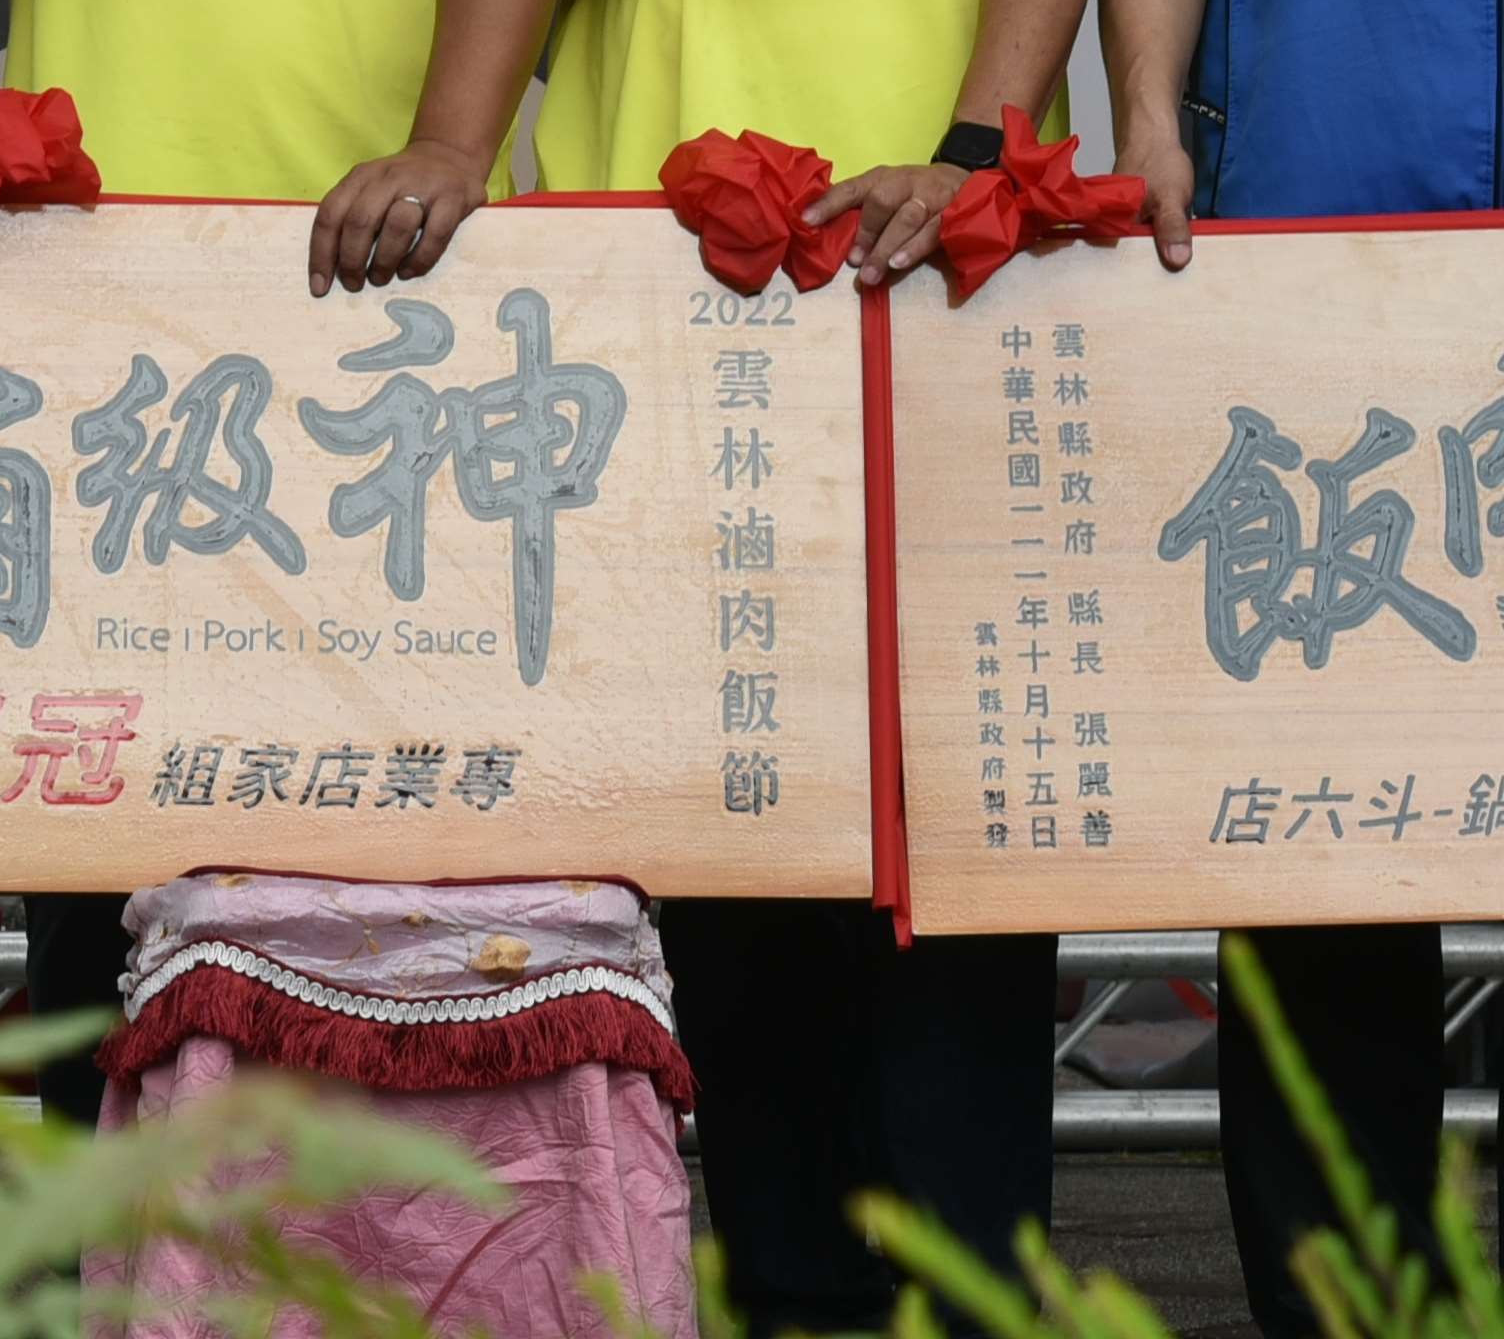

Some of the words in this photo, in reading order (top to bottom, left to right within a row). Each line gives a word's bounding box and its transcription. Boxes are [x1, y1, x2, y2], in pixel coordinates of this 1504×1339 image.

[688, 290, 797, 327] 2022
[1051, 323, 1097, 556] 雲林縣政府
[95, 618, 172, 654] Rice
[203, 618, 286, 654] Pork
[317, 619, 383, 662] Soy
[393, 620, 498, 656] Sauce
[709, 348, 782, 816] 雲林滷肉飯節
[1000, 324, 1060, 849] 中華民國一一一年十月十五日
[1066, 589, 1105, 676] 縣長
[973, 620, 1009, 849] 雲林縣政府製發
[1072, 711, 1113, 847] 張麗善
